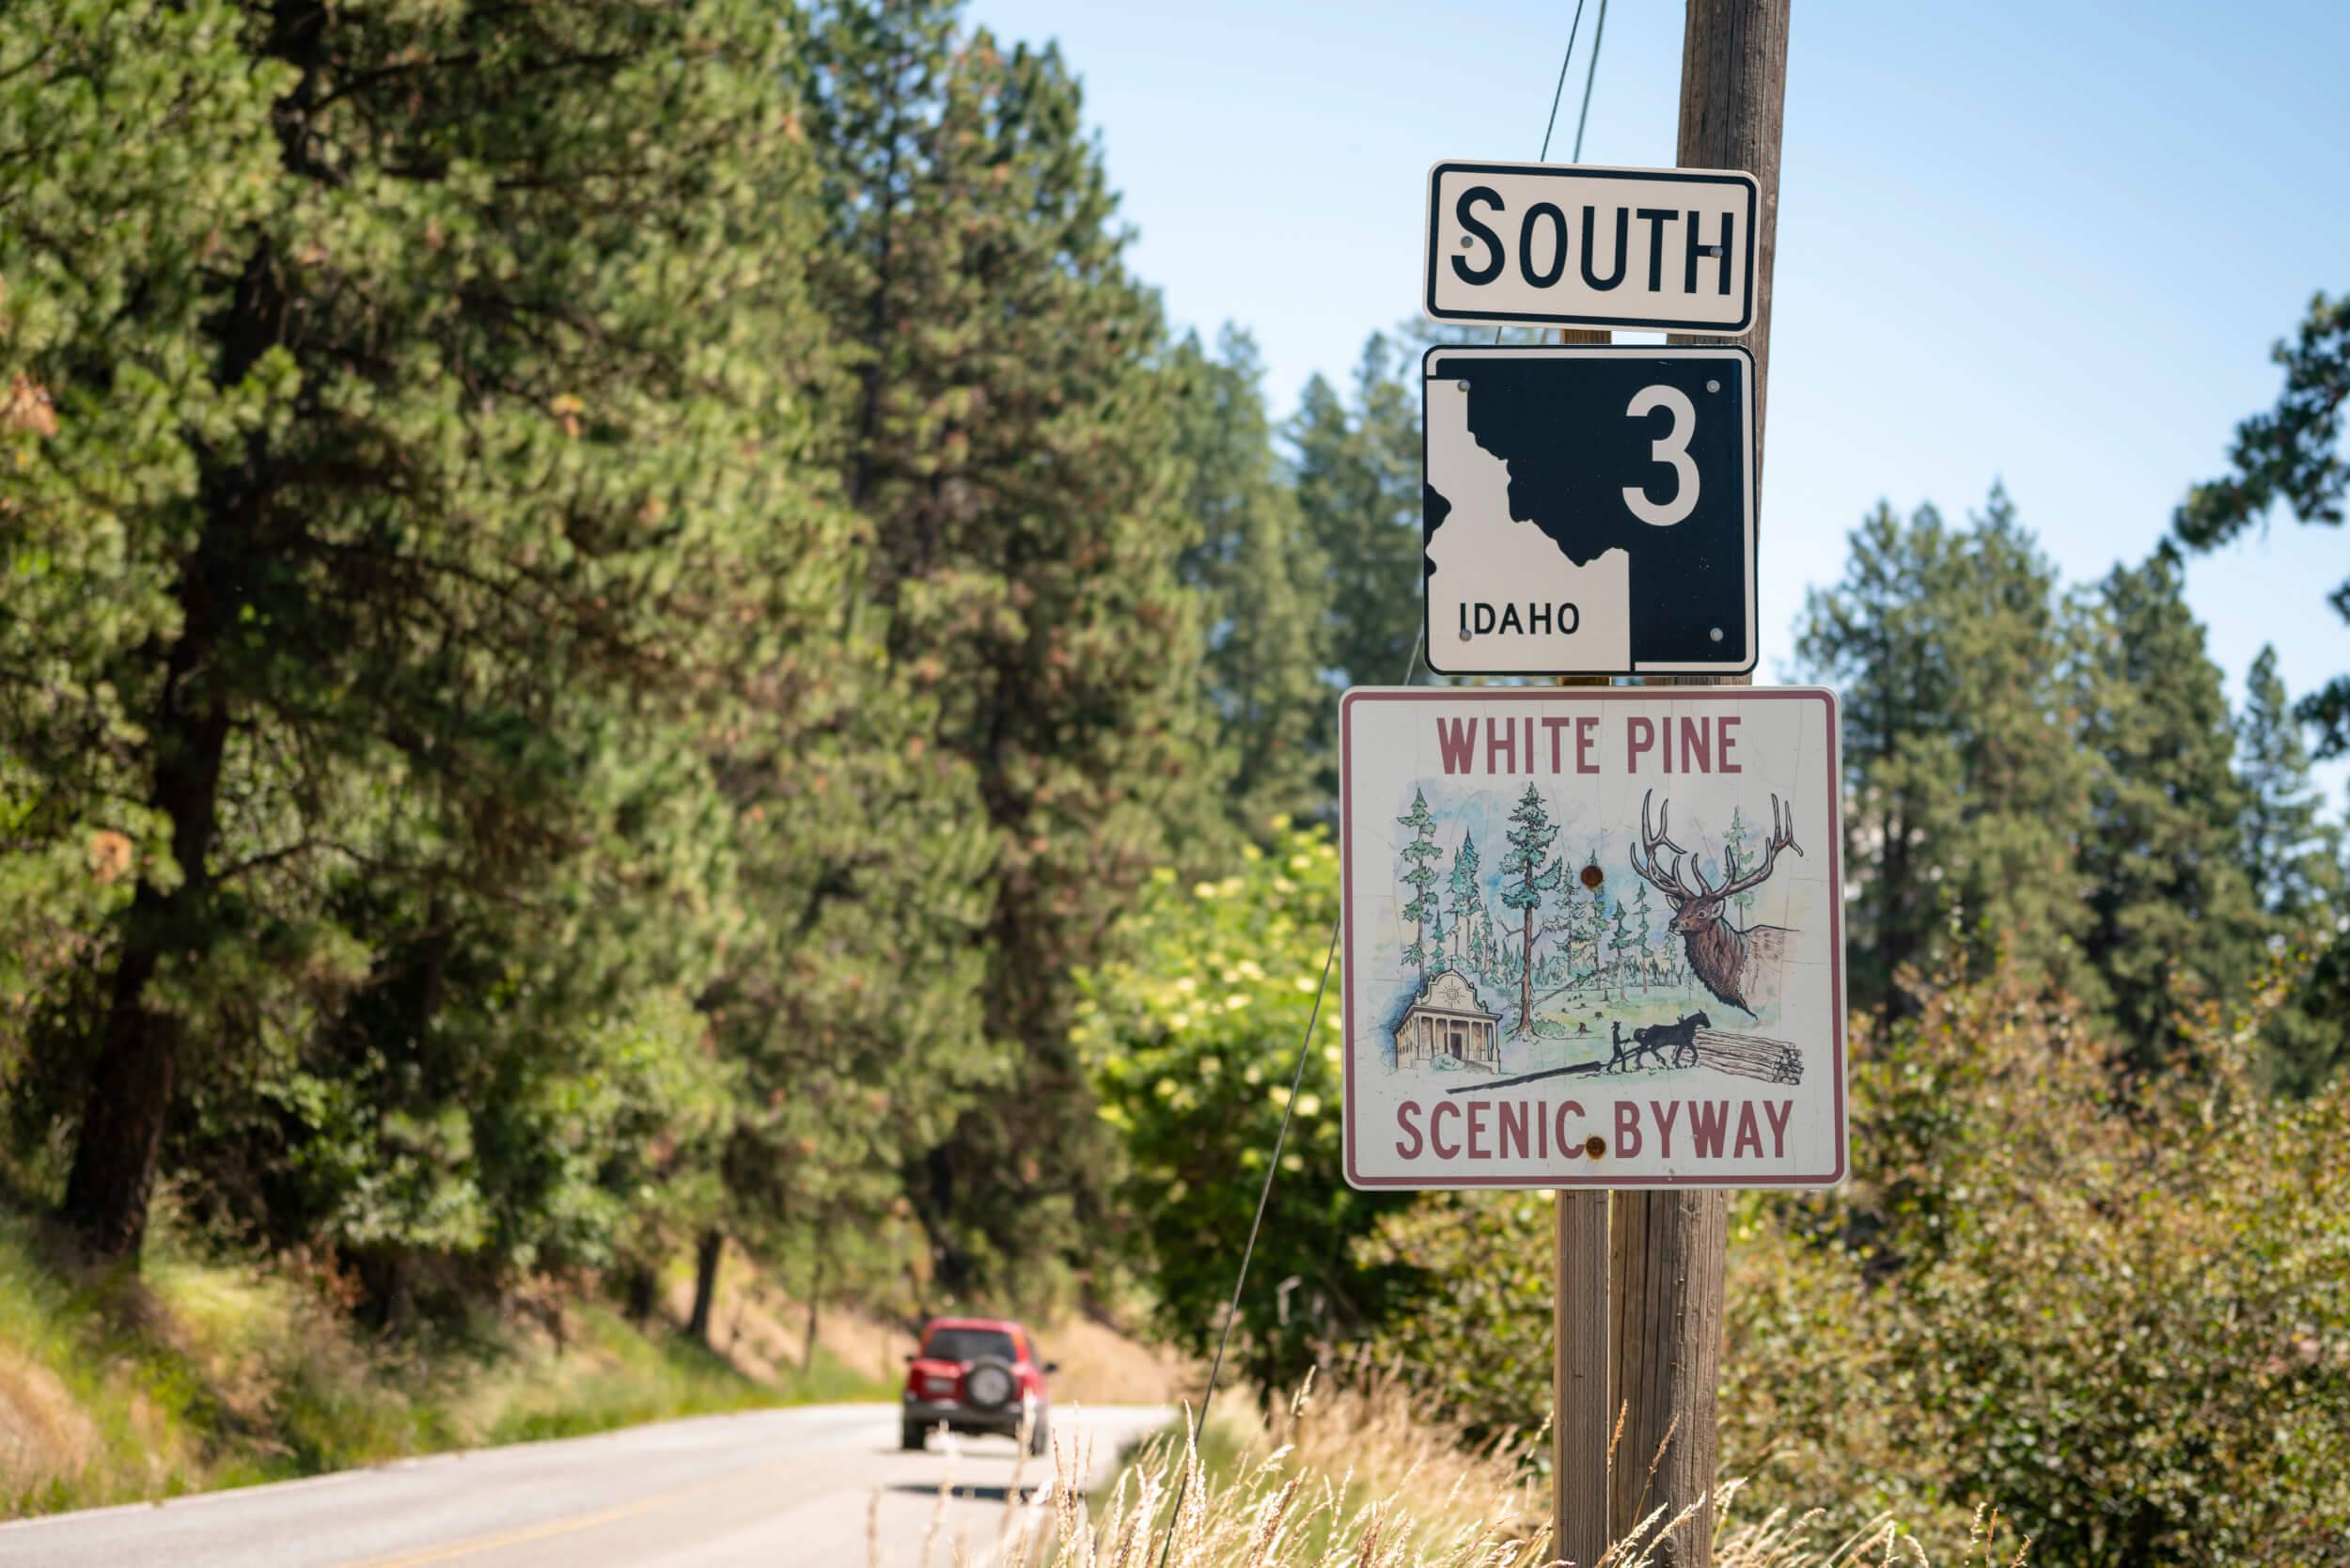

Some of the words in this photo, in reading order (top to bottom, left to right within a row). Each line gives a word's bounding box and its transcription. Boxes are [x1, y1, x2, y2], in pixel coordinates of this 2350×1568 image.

[1450, 186, 1734, 296] SOUTH
[1622, 384, 1700, 526] 3
[1459, 603, 1580, 635] IDAHO
[1436, 716, 1600, 775] WHITE
[1627, 716, 1743, 774] PINE
[1396, 1100, 1587, 1160] SCENIC
[1615, 1100, 1794, 1159] BYWAY
